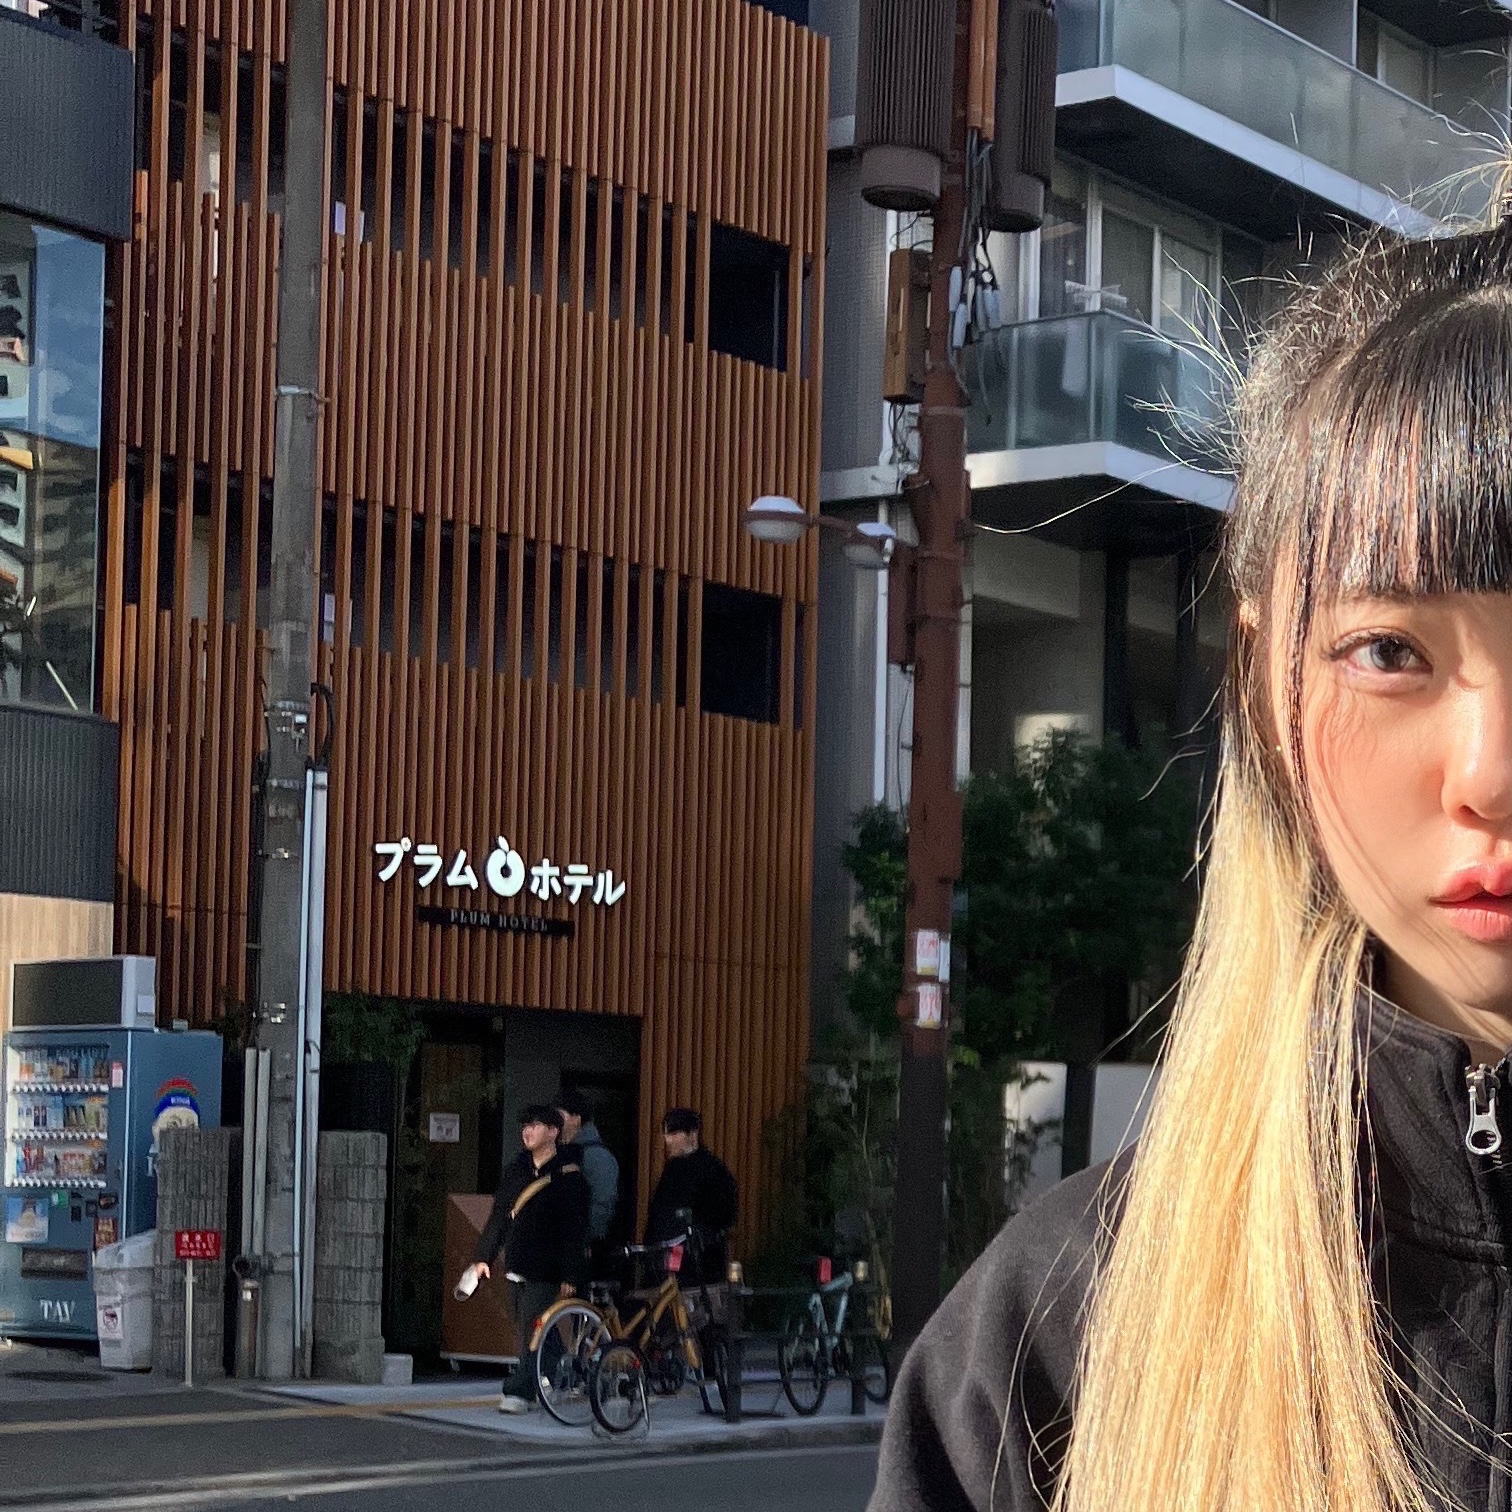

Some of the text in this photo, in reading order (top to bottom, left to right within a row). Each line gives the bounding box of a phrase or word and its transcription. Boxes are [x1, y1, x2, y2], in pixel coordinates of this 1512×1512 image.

[375, 836, 626, 906] プラム ホテル
[450, 908, 548, 932] PLUM HOTEL
